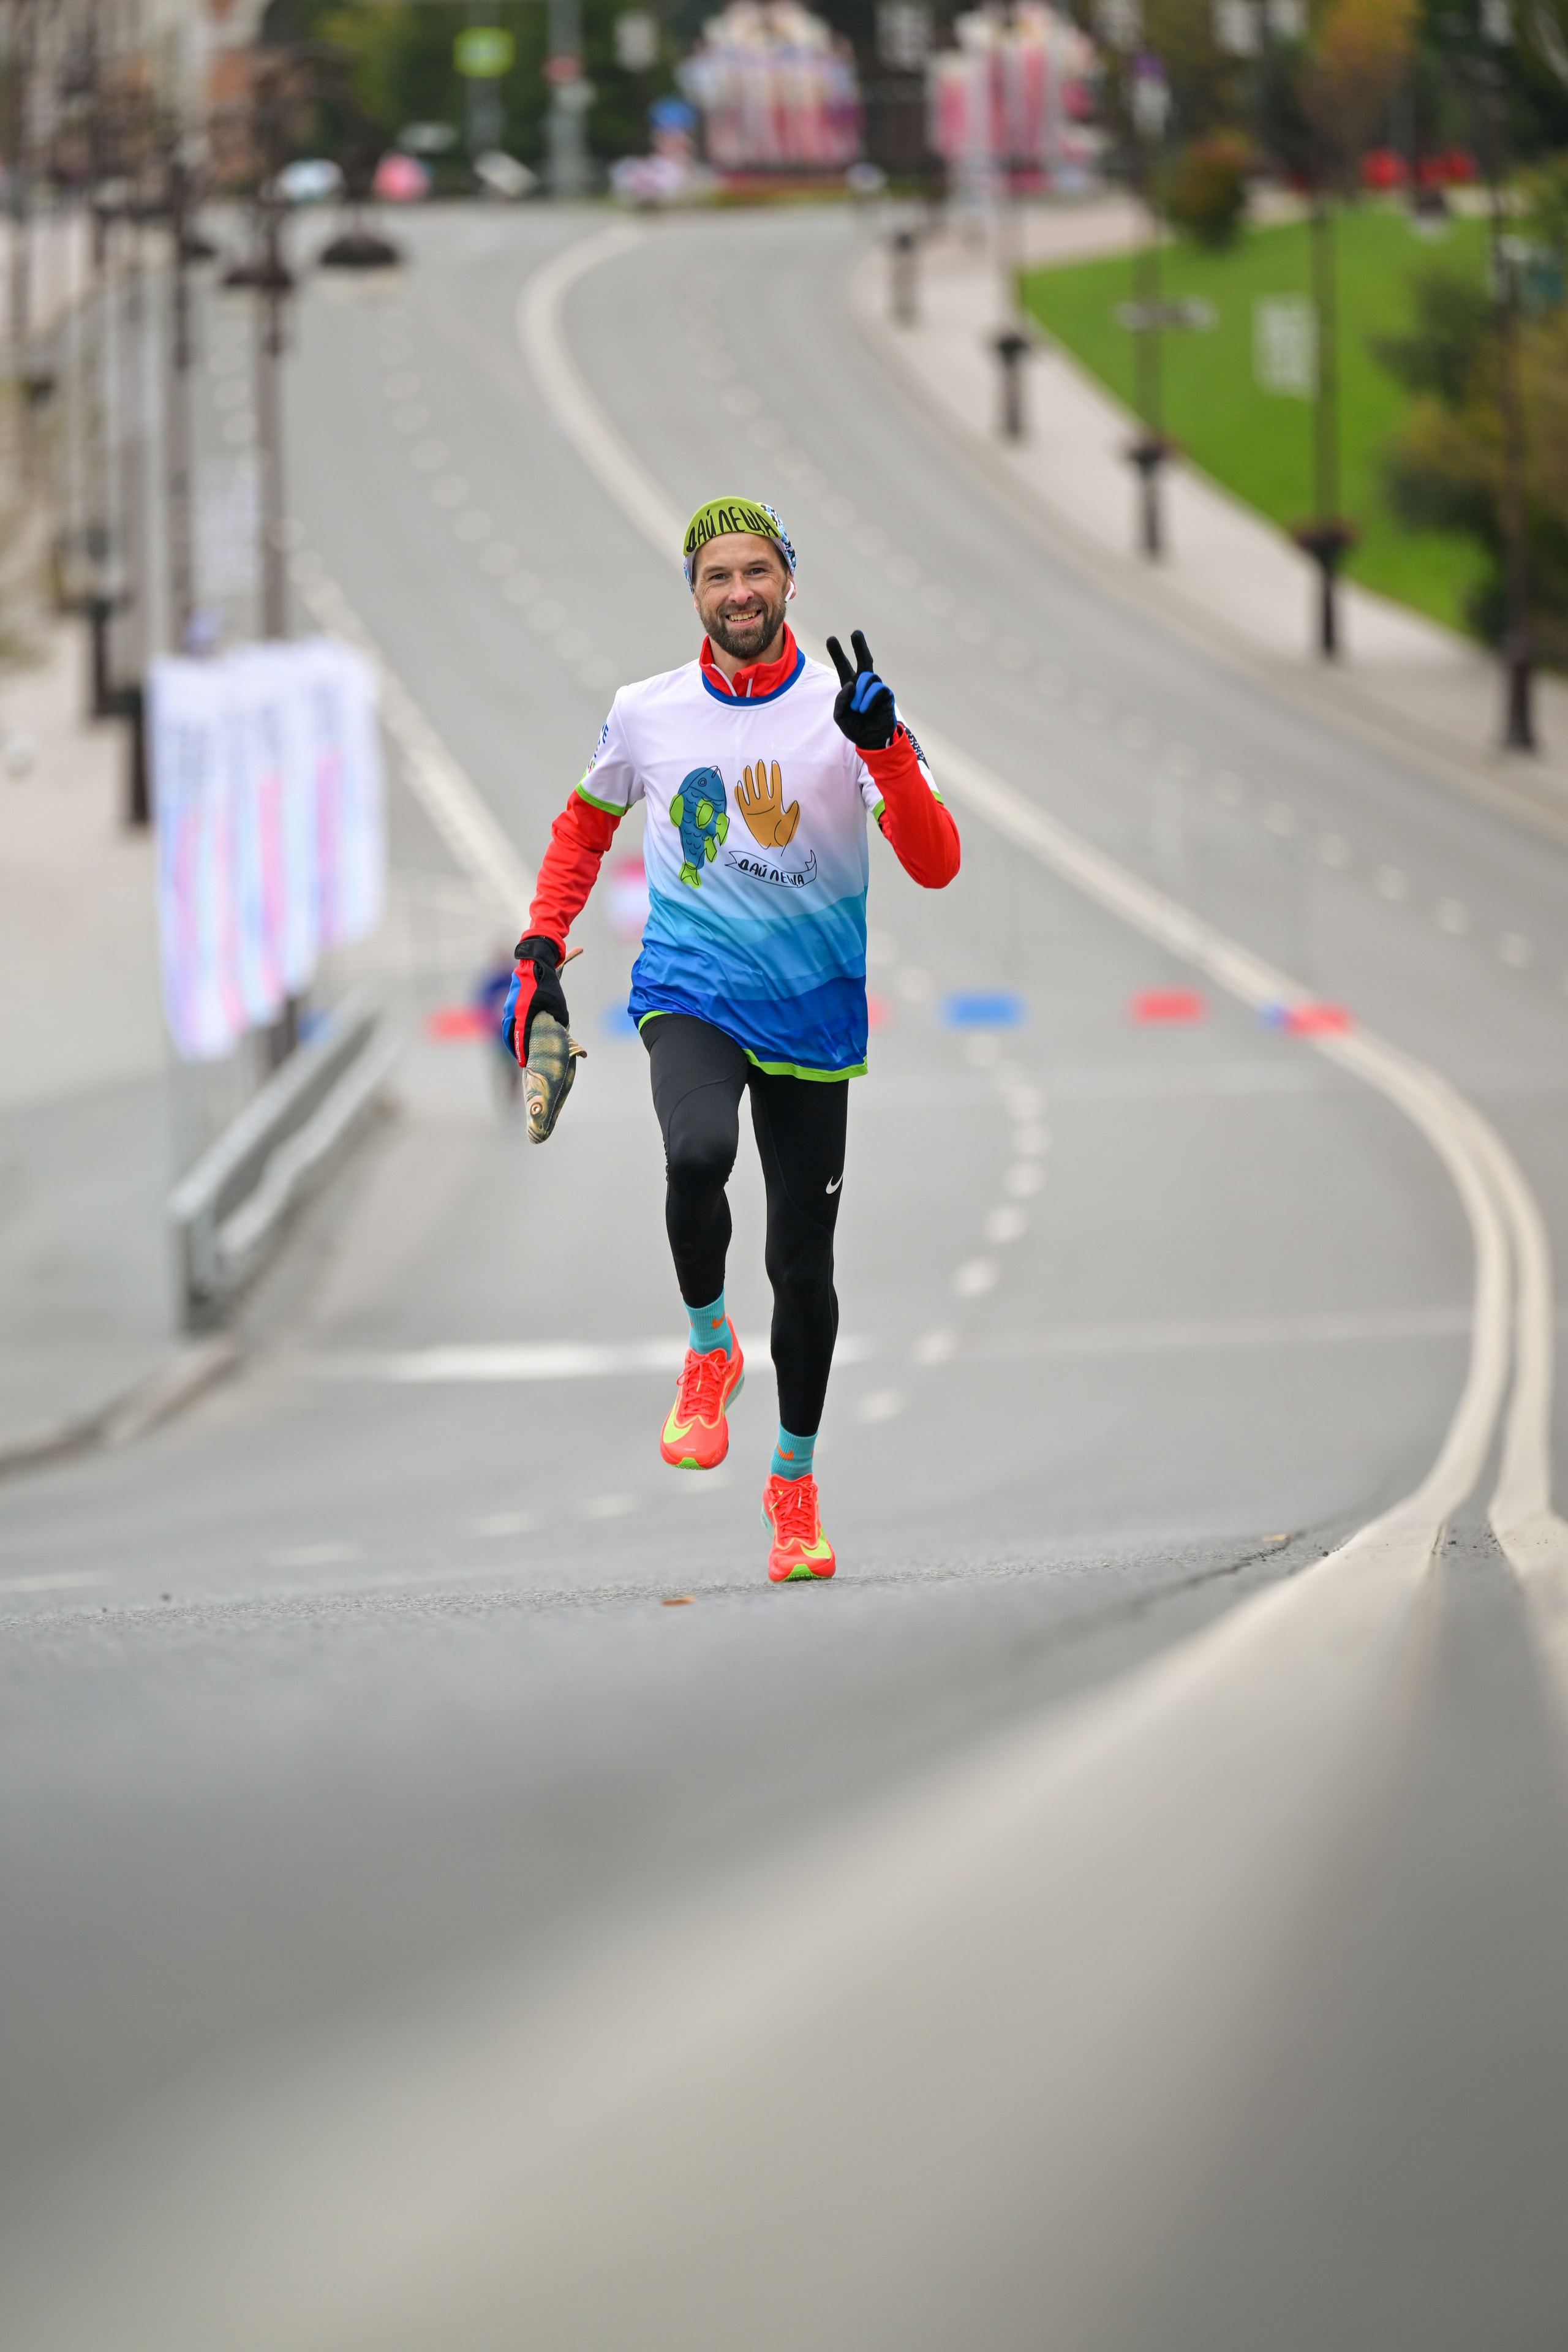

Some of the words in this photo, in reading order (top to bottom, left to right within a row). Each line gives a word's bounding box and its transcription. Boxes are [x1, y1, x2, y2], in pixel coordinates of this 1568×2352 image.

[686, 509, 717, 552] ДАЙ
[718, 506, 779, 538] ЛЕЩА
[737, 859, 767, 878] ДАЙ
[769, 870, 805, 887] ЛЕЩА
